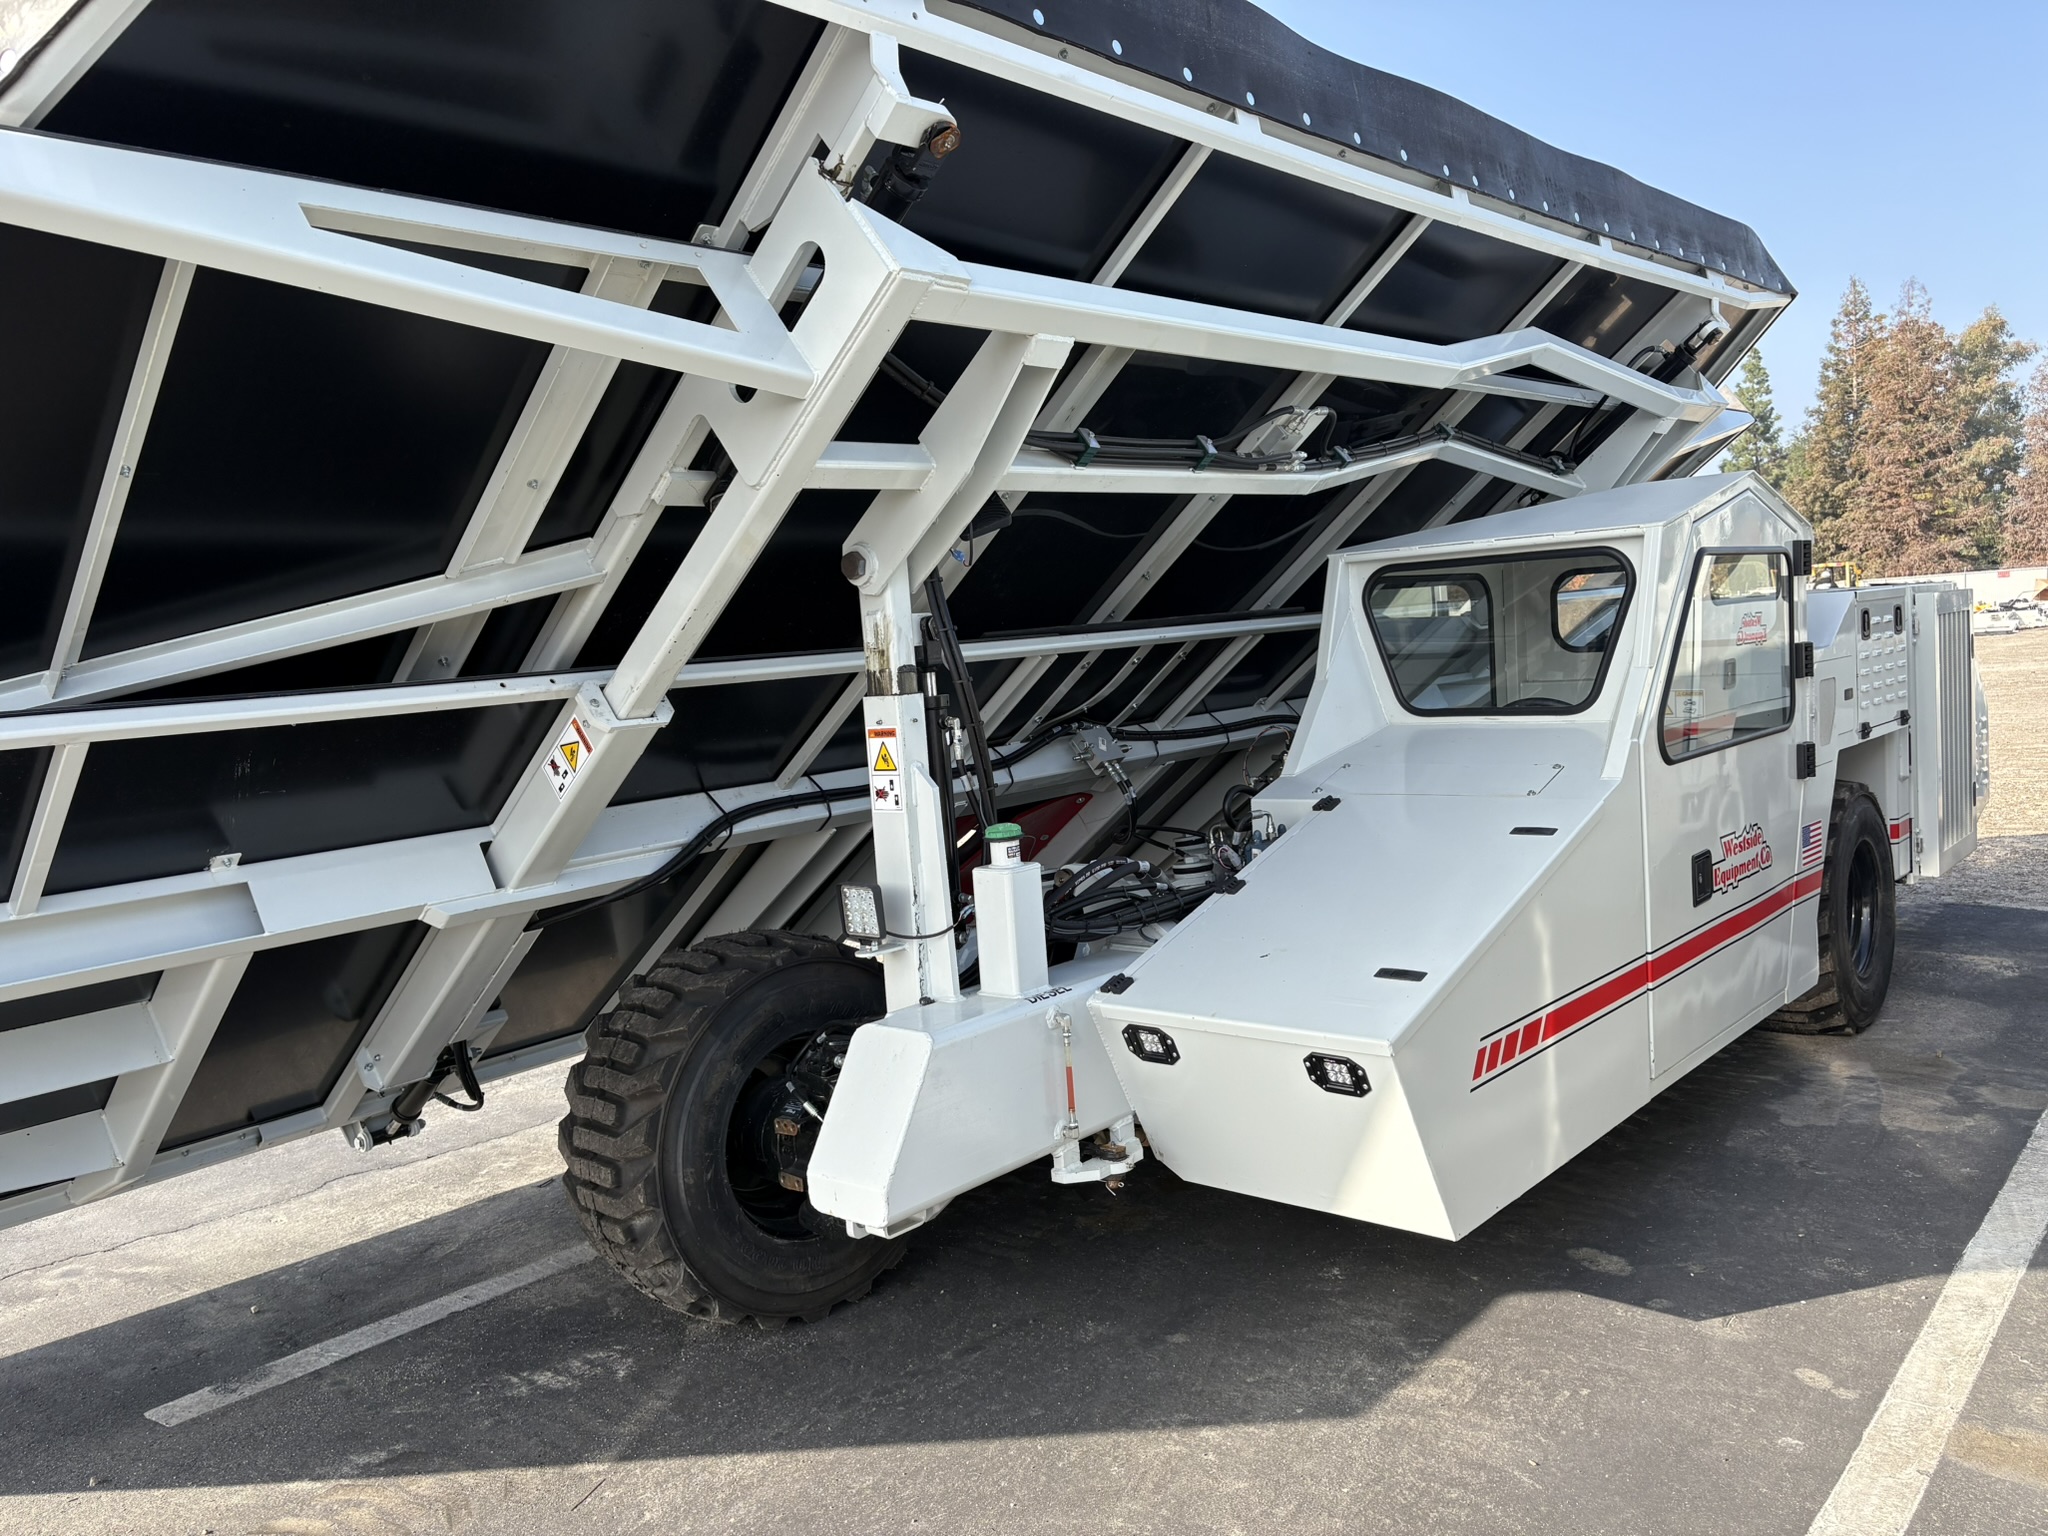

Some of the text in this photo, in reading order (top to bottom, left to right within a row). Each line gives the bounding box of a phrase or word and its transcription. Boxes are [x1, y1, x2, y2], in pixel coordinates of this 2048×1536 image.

[1723, 830, 1762, 859] Westside
[1714, 846, 1772, 888] Equipment Co
[1025, 986, 1072, 1004] DIESEL
